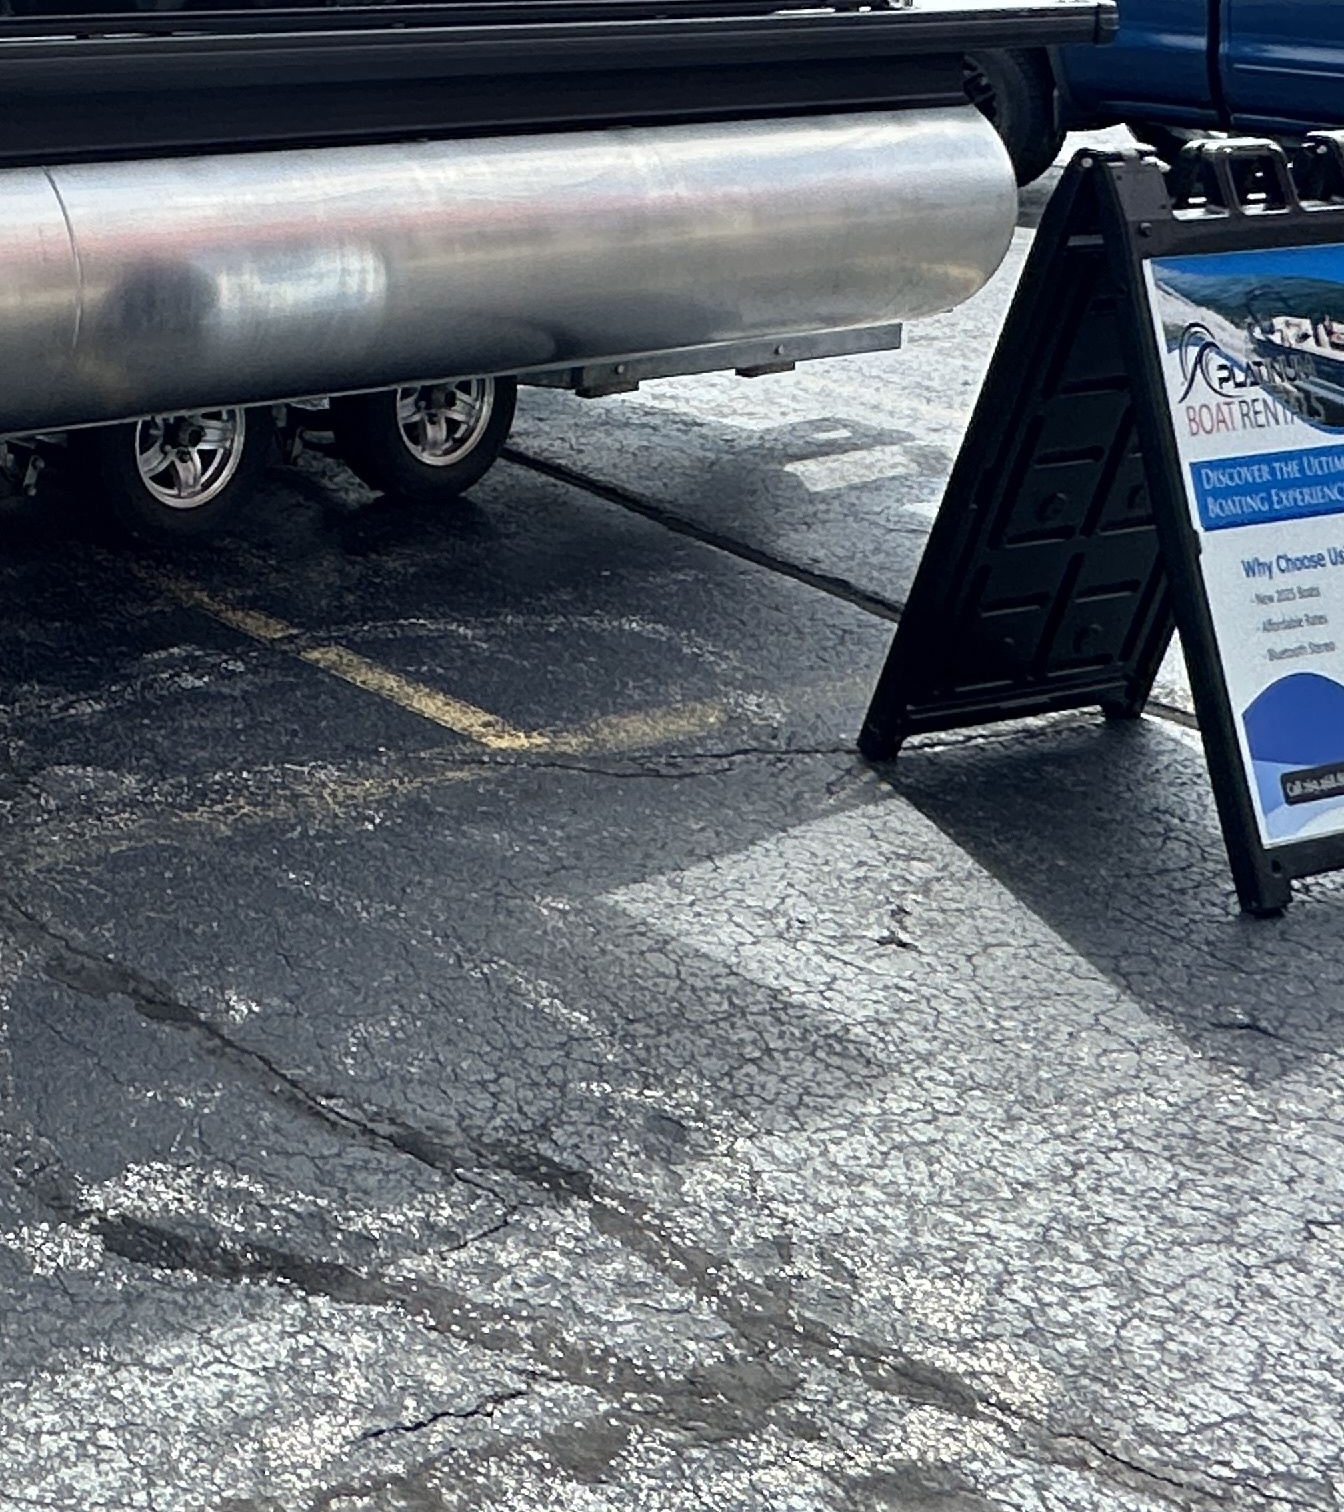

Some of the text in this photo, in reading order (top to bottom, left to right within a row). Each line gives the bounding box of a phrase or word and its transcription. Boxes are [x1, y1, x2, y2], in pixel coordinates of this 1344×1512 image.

[1216, 354, 1316, 390] PLATINUM
[1186, 400, 1237, 437] BOAT
[1201, 464, 1272, 490] DISCOVER
[1273, 462, 1301, 480] THE
[1207, 492, 1270, 518] BOATING
[1241, 556, 1274, 580] Why
[1276, 551, 1326, 574] Choose
